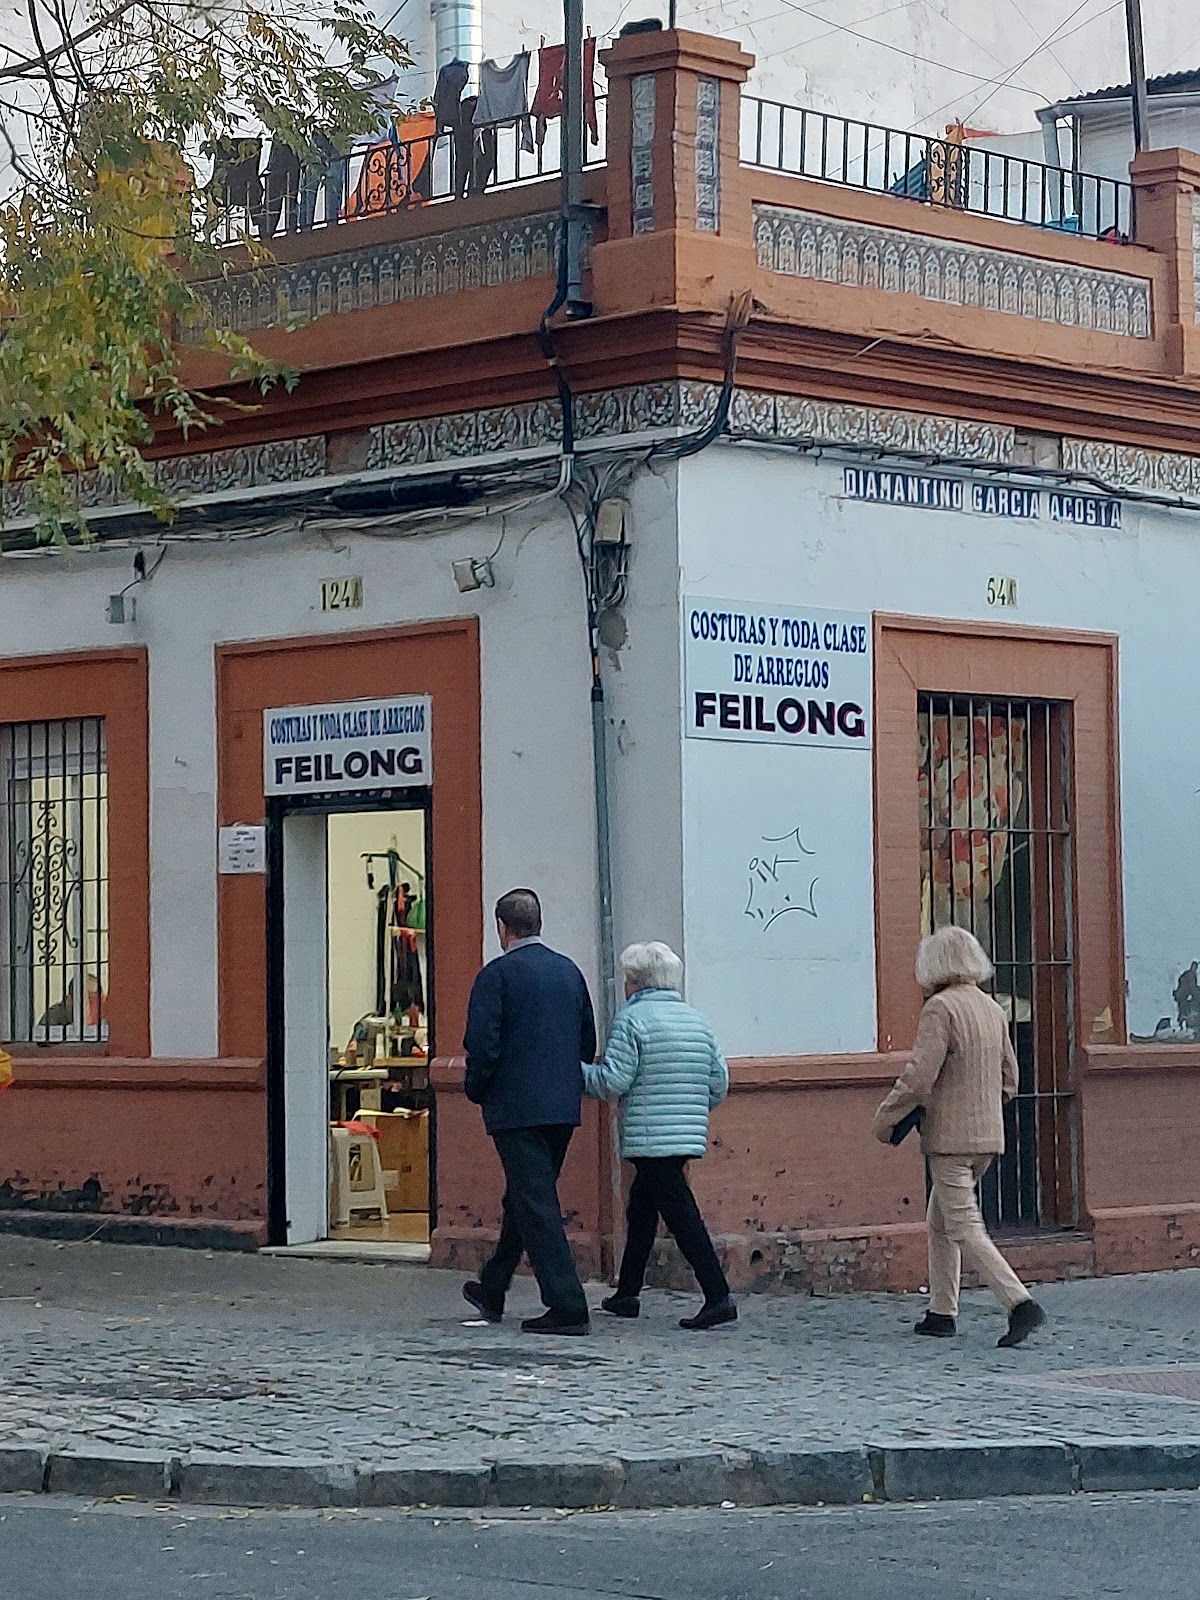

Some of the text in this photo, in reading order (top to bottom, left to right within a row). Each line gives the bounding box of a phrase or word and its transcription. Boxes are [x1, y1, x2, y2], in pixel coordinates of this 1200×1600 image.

[845, 469, 1122, 528] DIAMANTINO GARCIA ACOSTA
[690, 610, 867, 653] COSTURAS Y TODA CLASE
[734, 653, 829, 690] DE ARREGLOS
[270, 715, 311, 745] COSTURAS
[319, 713, 342, 741] TODA
[342, 708, 368, 738] CLASE
[369, 708, 381, 736] DE
[382, 704, 425, 736] ARREGLOS
[695, 691, 866, 738] FEILONG
[275, 747, 423, 785] FEILONG
